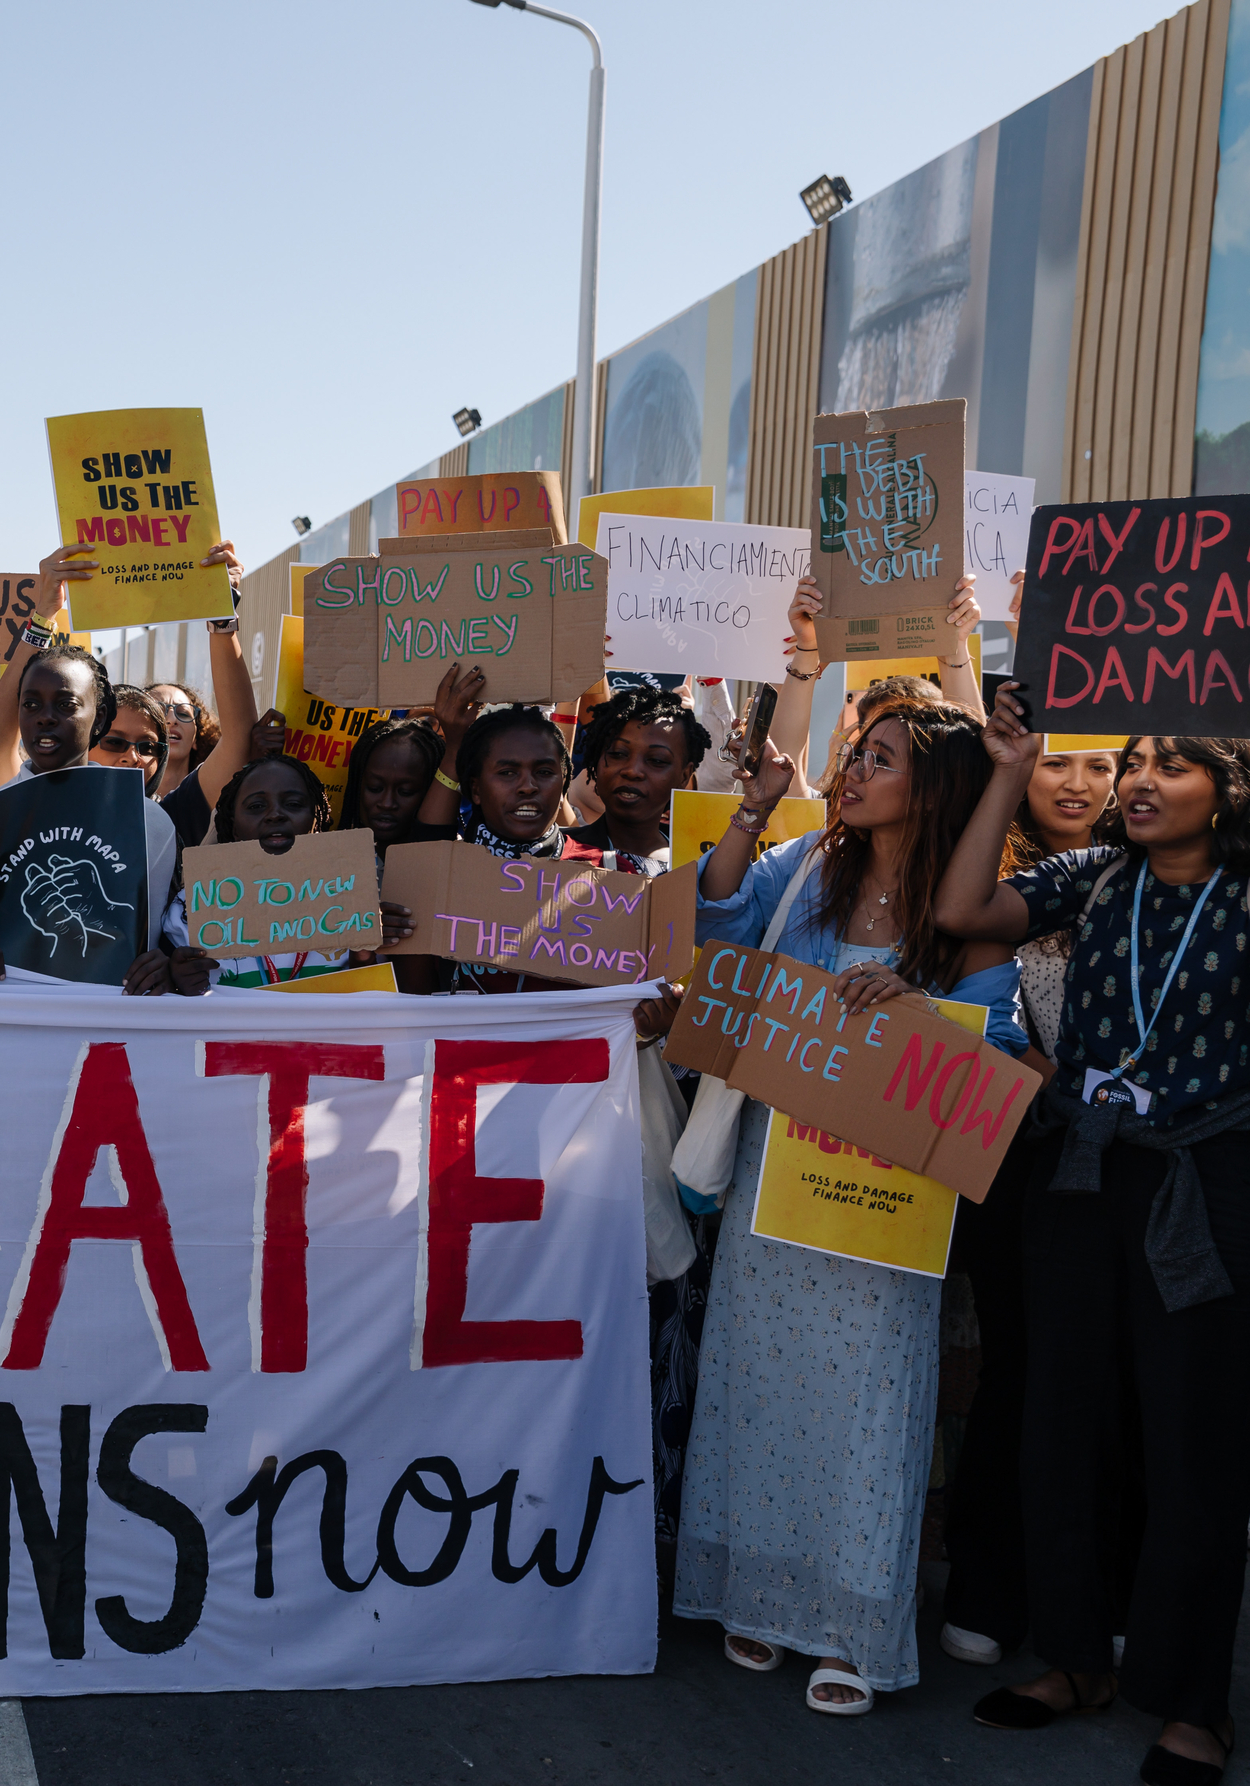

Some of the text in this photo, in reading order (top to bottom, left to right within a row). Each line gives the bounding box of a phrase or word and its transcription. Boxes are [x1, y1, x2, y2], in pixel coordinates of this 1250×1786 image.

[81, 449, 172, 482] SHOW
[813, 438, 893, 478] THE
[857, 453, 927, 497] DEBT
[98, 481, 199, 512] US THE
[401, 488, 463, 530] PAY
[477, 487, 521, 523] UP
[819, 492, 849, 523] IS
[856, 485, 936, 521] WITH
[75, 514, 192, 547] MONEY
[823, 520, 907, 566] THE
[1038, 506, 1231, 580] PAY UP
[101, 561, 195, 575] LOSS AND DAMAGE
[114, 572, 184, 585] FINANCE NOW
[315, 554, 594, 609] SHOW US THE
[859, 543, 943, 585] SOUTH
[617, 592, 751, 628] CLIMATICO
[905, 616, 933, 625] BRICK
[1065, 572, 1250, 637] LOSS A
[382, 612, 518, 663] MONEY
[1045, 643, 1250, 709] DAMA
[306, 699, 379, 737] US THE
[39, 826, 84, 844] WITH
[85, 834, 128, 874] MAPA
[191, 874, 356, 913] NO TO NEW
[500, 861, 643, 915] SHOW
[269, 916, 316, 943] AND
[318, 905, 376, 935] GAS
[538, 908, 602, 937] US
[434, 914, 522, 958] THE
[529, 935, 656, 984] MONEY
[692, 995, 849, 1082] JUSTICE
[882, 1032, 1025, 1150] NOW
[801, 1173, 914, 1204] LOSS AND DAMAGE
[813, 1187, 897, 1214] FINANCE NOW
[225, 1449, 646, 1599] now
